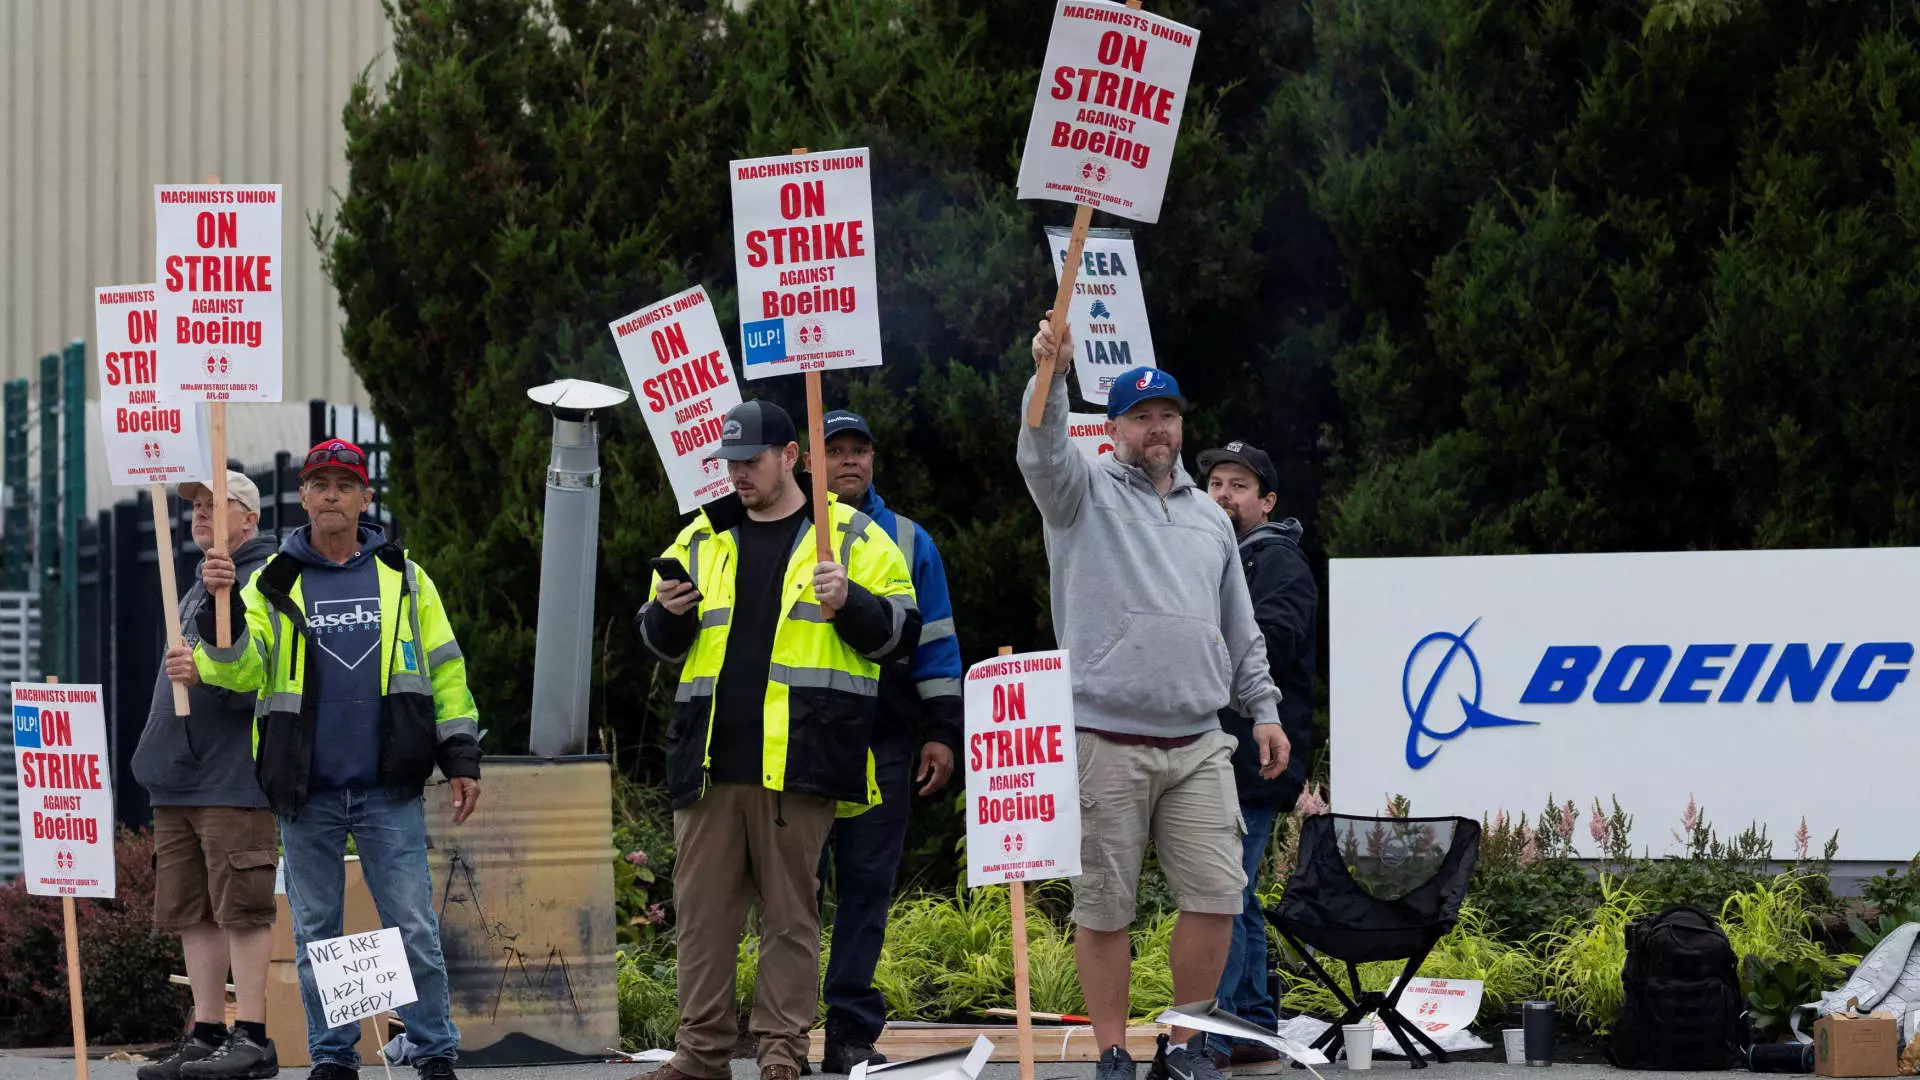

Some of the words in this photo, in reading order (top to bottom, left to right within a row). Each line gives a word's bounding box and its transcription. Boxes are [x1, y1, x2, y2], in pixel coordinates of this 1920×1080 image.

[1063, 5, 1149, 31] MACHINISTS
[1151, 23, 1193, 47] UNION
[1097, 30, 1148, 73] ON
[1051, 66, 1175, 126] STRIKE
[1076, 108, 1136, 134] AGAINST
[1051, 121, 1150, 170] Boeing
[737, 160, 819, 181] MACHINISTS
[823, 156, 864, 171] UNION
[161, 191, 234, 204] MACHINISTS
[237, 191, 276, 203] UNION
[780, 180, 825, 220] ON
[1073, 186, 1101, 199] DISTRICT
[1074, 194, 1100, 207] AFL-CIO
[196, 211, 237, 249] ON
[746, 220, 865, 268] STRIKE
[165, 255, 272, 292] STRIKE
[779, 266, 835, 286] AGAINST
[99, 290, 154, 305] MACHINISTS
[762, 286, 855, 318] Boeing
[1075, 283, 1117, 295] STANDS
[192, 299, 244, 314] AGAINST
[617, 304, 673, 338] MACHINISTS
[673, 292, 705, 313] UNION
[127, 310, 157, 345] ON
[176, 316, 262, 348] Boeing
[747, 329, 781, 348] ULP!
[1089, 323, 1117, 335] WITH
[650, 322, 689, 364] ON
[796, 352, 824, 361] DISTRICT
[1085, 340, 1132, 365] IAM
[800, 361, 825, 370] AFL-CIO
[642, 350, 729, 413] STRIKE
[129, 390, 160, 405] AGAIN
[675, 397, 714, 425] AGAINST
[116, 406, 181, 434] Boeing
[1068, 424, 1104, 437] ACHIN
[968, 661, 1021, 680] MACHINISTS
[1023, 657, 1062, 673] UNION
[1519, 641, 1915, 704] BOEING
[16, 688, 65, 703] MACHINISTS
[68, 690, 97, 703] UNION
[992, 682, 1026, 723] ON
[17, 716, 38, 732] ULP!
[40, 710, 72, 746] ON
[970, 725, 1064, 772] STRIKE
[22, 752, 102, 790] STRIKE
[989, 772, 1035, 792] AGAINST
[43, 795, 81, 811] AGAINST
[978, 792, 1055, 825] Boeing
[33, 812, 97, 844] Boeing
[309, 941, 344, 963] WE
[349, 933, 381, 954] ARE
[342, 955, 381, 975] NOT
[321, 977, 364, 1005] LAZY
[376, 971, 398, 984] OR
[330, 990, 392, 1024] GREEDY
